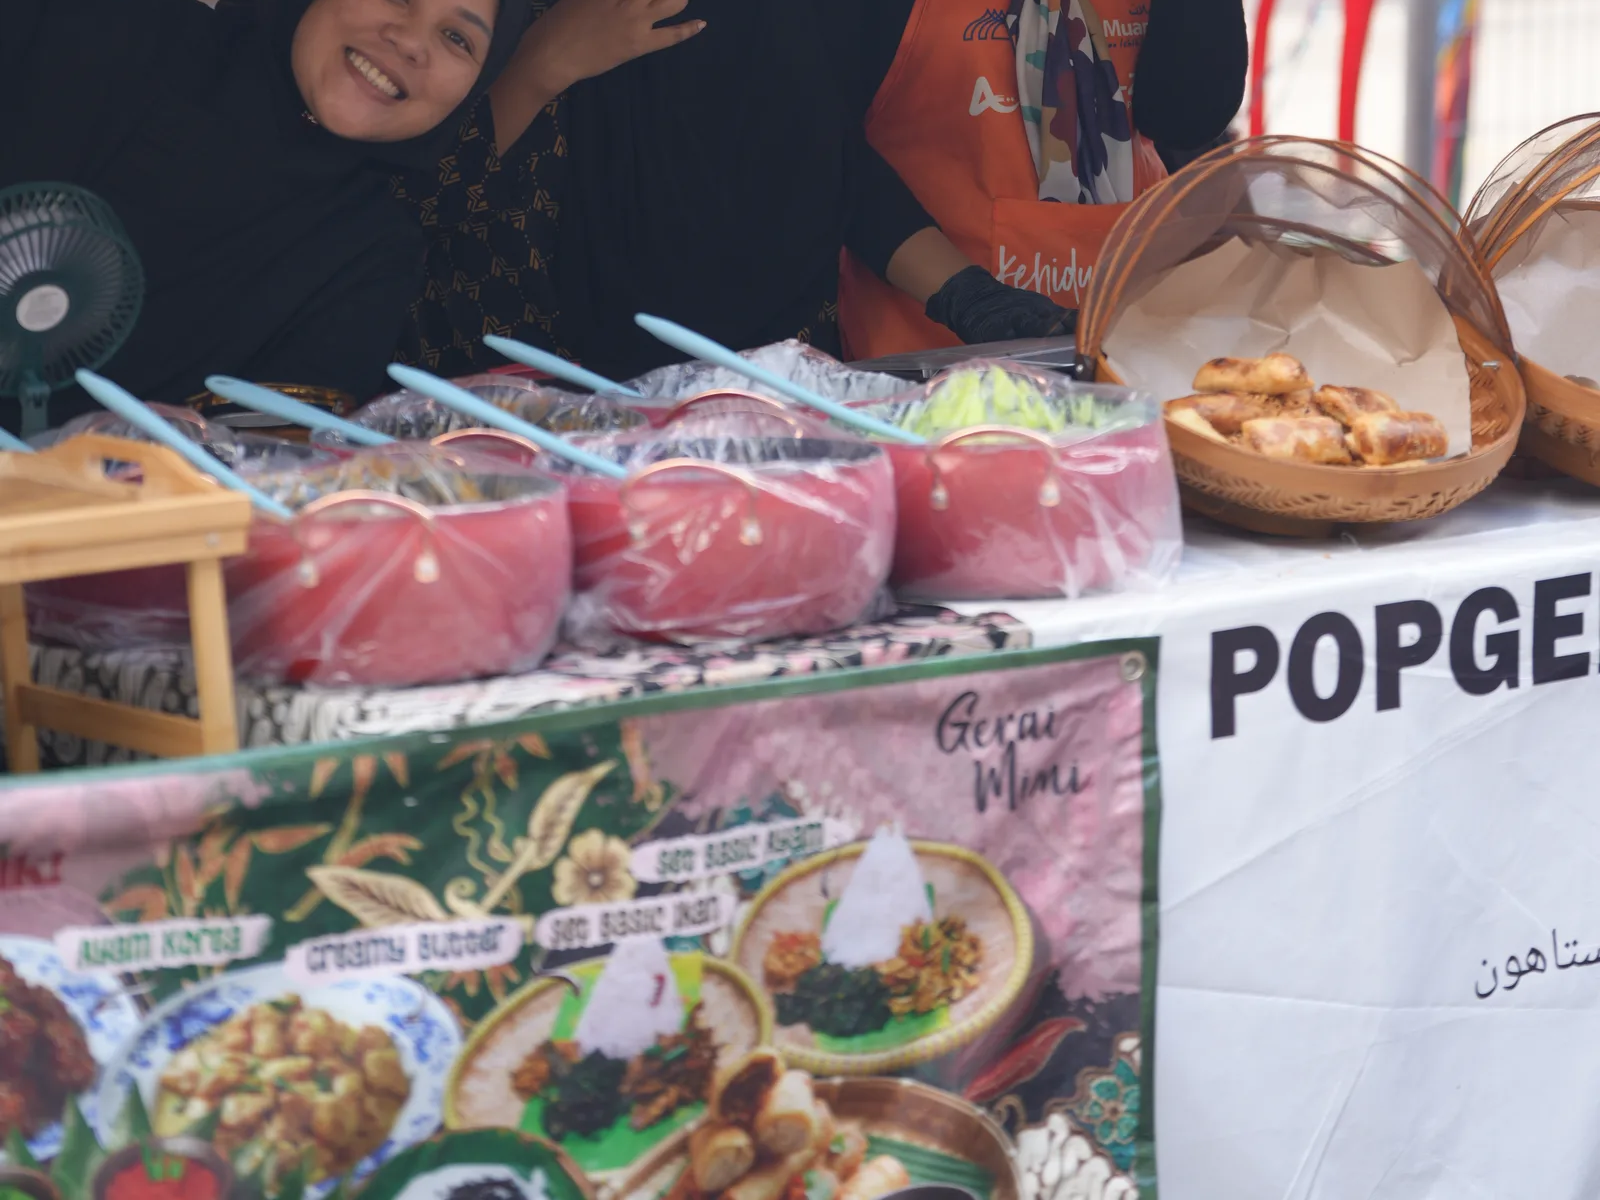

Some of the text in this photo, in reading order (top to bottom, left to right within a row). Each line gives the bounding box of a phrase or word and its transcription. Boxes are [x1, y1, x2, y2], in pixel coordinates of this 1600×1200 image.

[1211, 571, 1600, 740] POPGE
[935, 691, 1056, 755] Gerai
[975, 740, 1085, 813] Mimi
